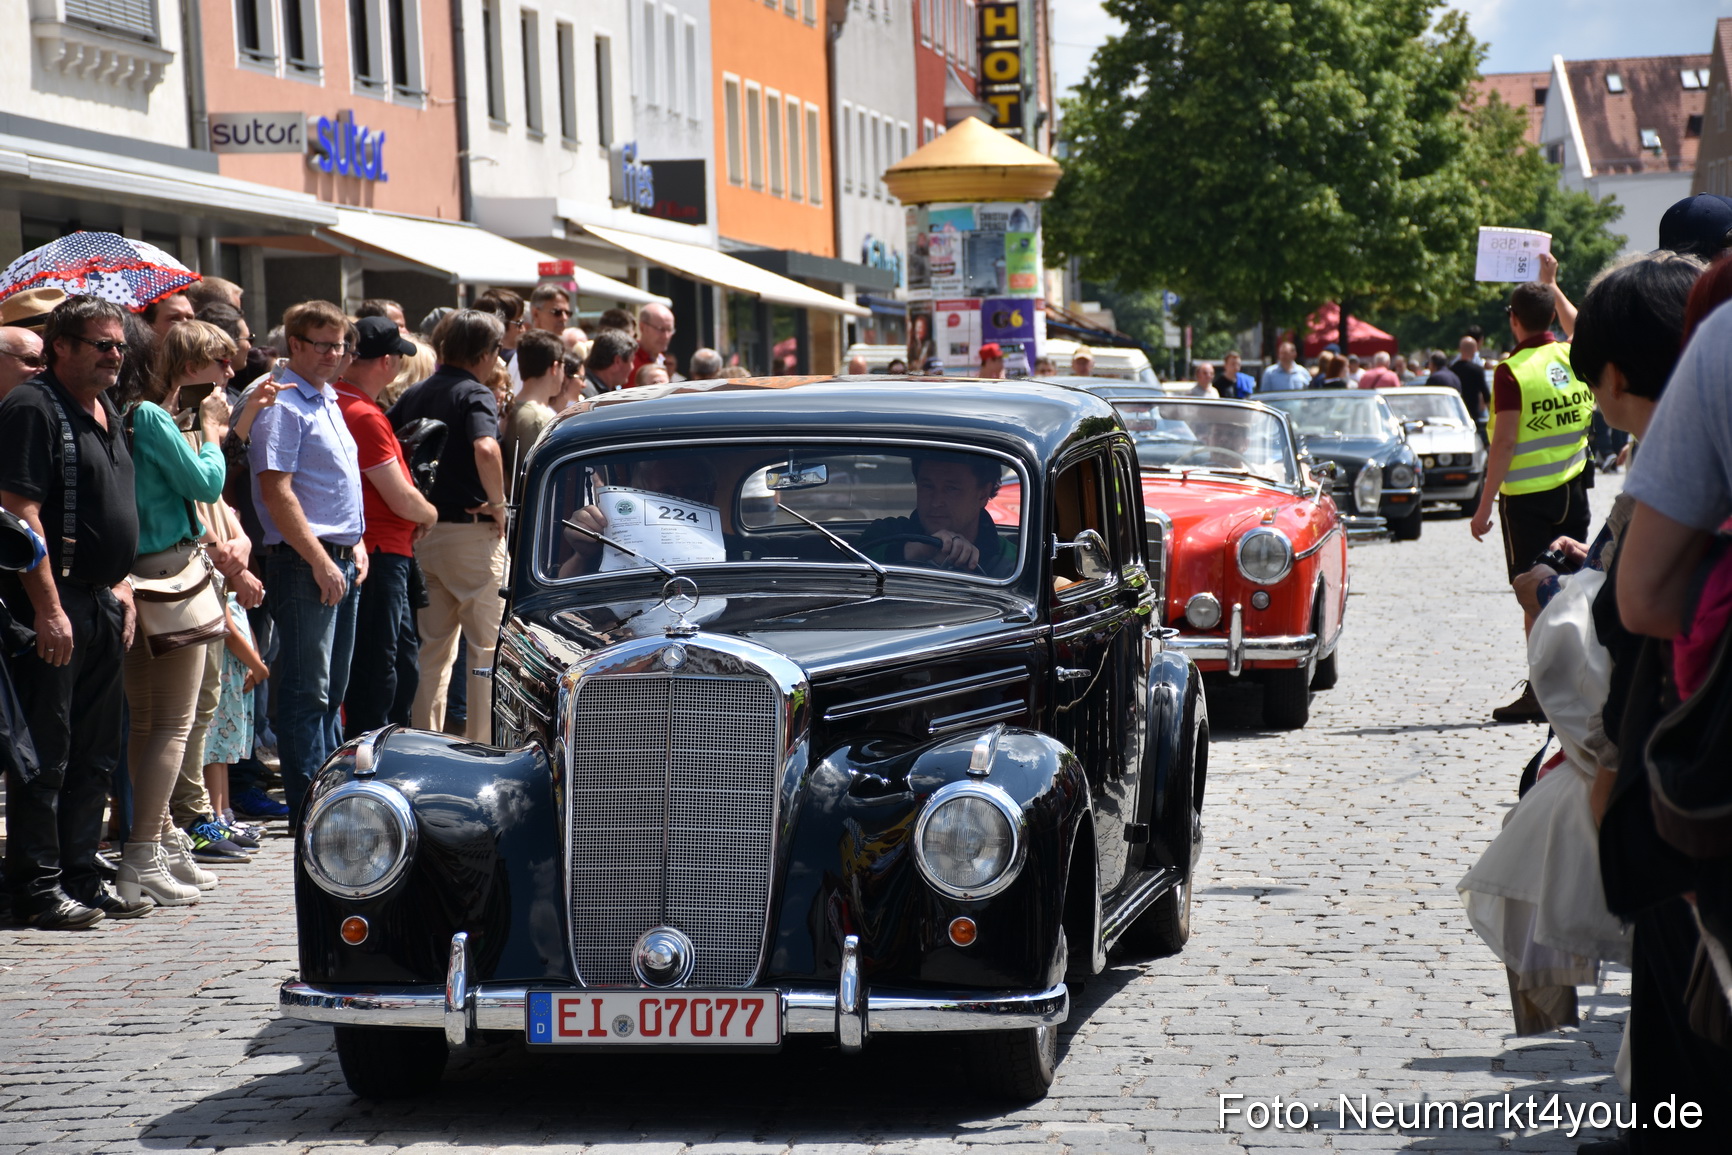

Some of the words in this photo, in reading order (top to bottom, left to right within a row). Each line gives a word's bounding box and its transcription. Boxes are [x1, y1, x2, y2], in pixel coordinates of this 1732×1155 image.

[983, 6, 1020, 124] HOT
[212, 118, 300, 145] sutor.
[1517, 256, 1527, 274] 356
[1531, 390, 1593, 415] FOLLOW
[1555, 409, 1582, 427] ME
[658, 505, 699, 524] 224
[536, 1022, 546, 1034] D
[558, 998, 608, 1038] EI
[639, 998, 764, 1038] 07077
